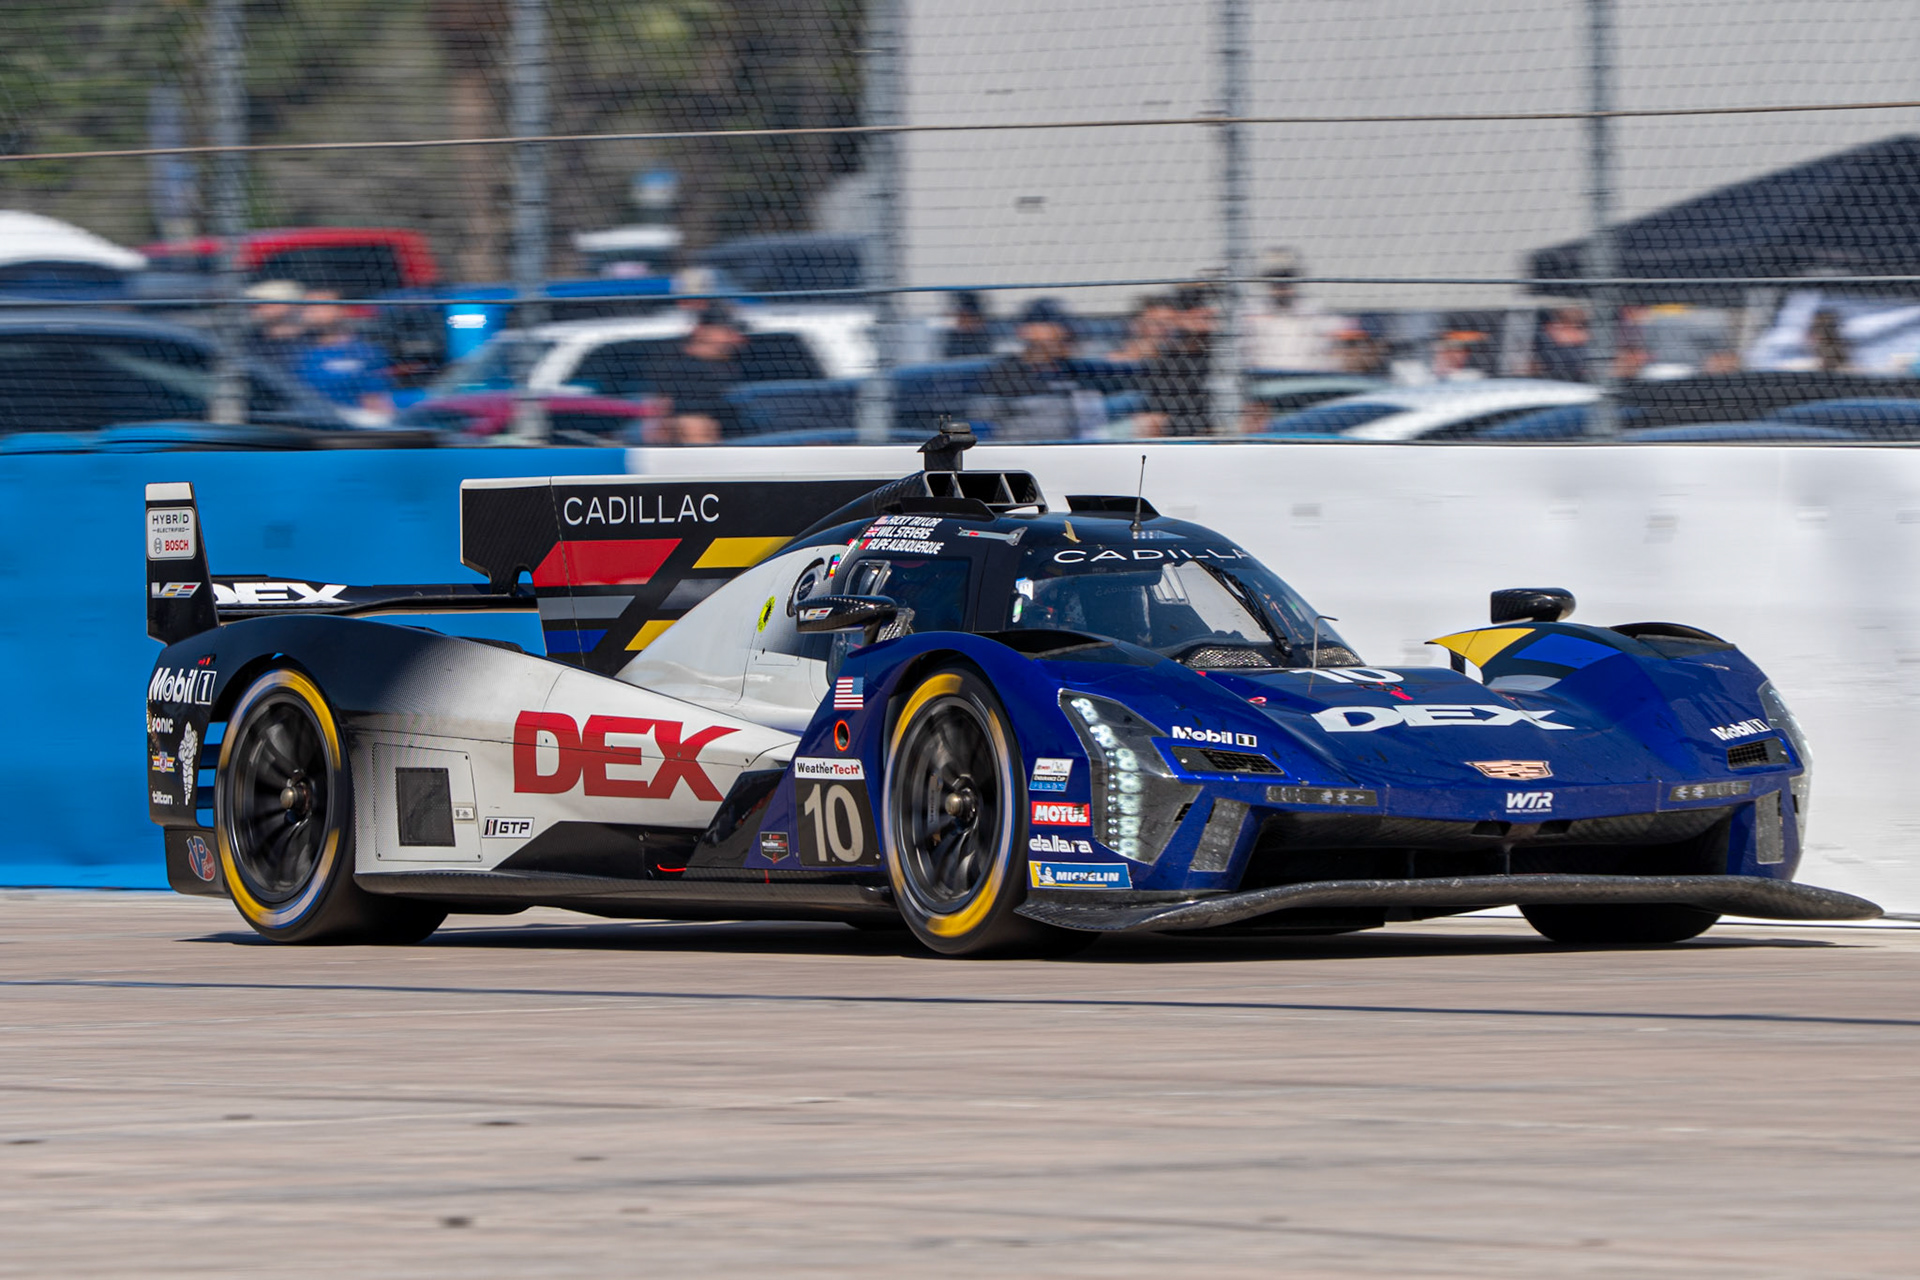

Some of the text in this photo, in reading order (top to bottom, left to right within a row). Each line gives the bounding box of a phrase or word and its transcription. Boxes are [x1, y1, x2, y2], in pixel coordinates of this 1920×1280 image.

[563, 493, 720, 526] CADILLAC
[152, 513, 190, 525] HYBRID
[909, 516, 943, 528] TAYLOR
[876, 526, 935, 540] WILL STEVENS
[165, 539, 189, 551] BOSCH
[1288, 667, 1405, 684] 10
[148, 667, 217, 705] Mobil 1
[1310, 704, 1576, 733] DEX
[1171, 725, 1258, 748] Mobil 1
[1709, 718, 1772, 741] Mobil 1
[513, 710, 743, 802] DEX
[797, 761, 860, 775] WeatherTech
[1506, 791, 1554, 809] WTR
[1034, 804, 1088, 823] MOTUL
[499, 821, 530, 835] GTP
[804, 783, 864, 863] 10
[1028, 834, 1094, 854] dallara
[1055, 870, 1120, 882] MICHELIN
